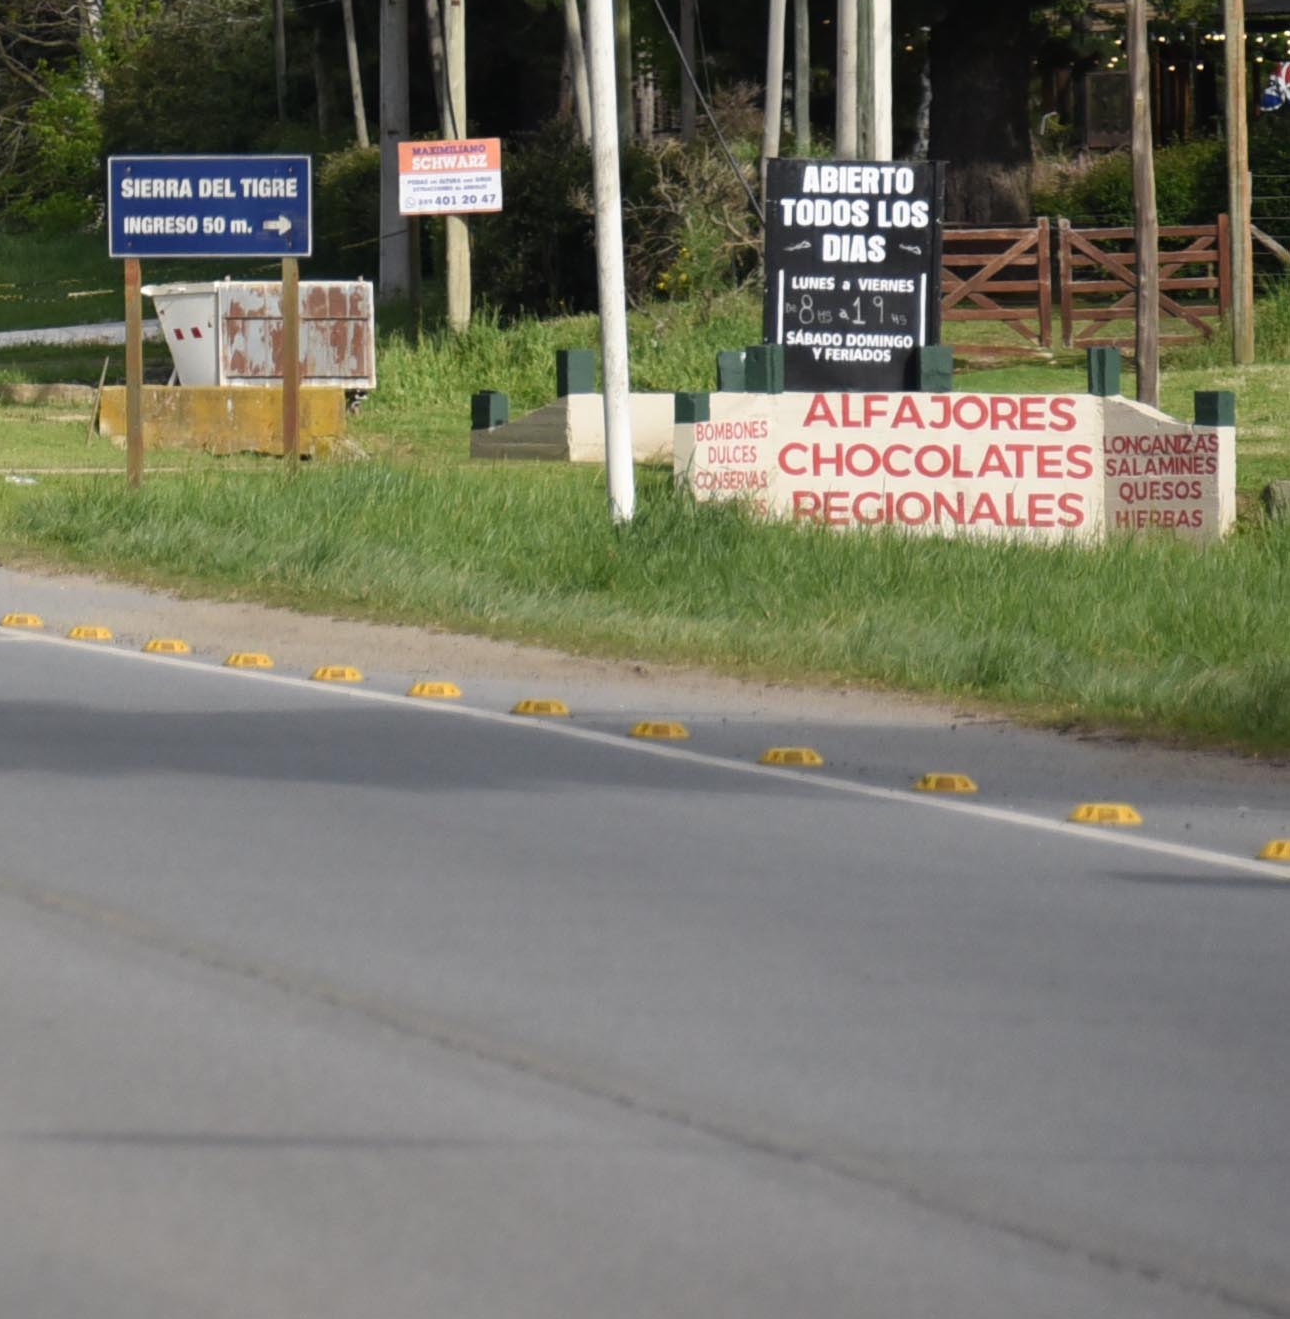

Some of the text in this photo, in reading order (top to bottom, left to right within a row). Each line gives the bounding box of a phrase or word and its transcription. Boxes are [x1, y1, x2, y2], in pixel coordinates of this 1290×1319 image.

[412, 144, 487, 156] MAXIMILIANO
[411, 154, 489, 171] SCHWARZ
[121, 178, 298, 199] SIERRA DEL TIGRE
[802, 165, 914, 195] ABIERTO
[434, 195, 457, 206] 401
[461, 194, 478, 205] 20
[482, 193, 496, 204] 47
[780, 198, 930, 228] TODOS LOS
[123, 216, 253, 235] INGRESO 50 m.
[822, 233, 887, 263] DIAS
[791, 276, 915, 293] LUNES a VIERNES
[799, 294, 815, 325] 8
[786, 328, 914, 349] SÁBADO DOMINGO
[812, 347, 892, 363] Y FERIADOS
[802, 393, 1078, 432] ALFAJORES
[695, 420, 769, 442] BOMBONES
[1103, 433, 1220, 455] LONGANIZAS
[707, 445, 758, 465] DULCES
[777, 442, 1094, 480] CHOCOLATES
[1105, 456, 1218, 477] SALAMINES
[695, 470, 768, 490] CONSERVAS
[1119, 480, 1203, 504] QUESOS
[792, 490, 1086, 528] REGIONALES
[1115, 509, 1204, 528] HIERBAS
